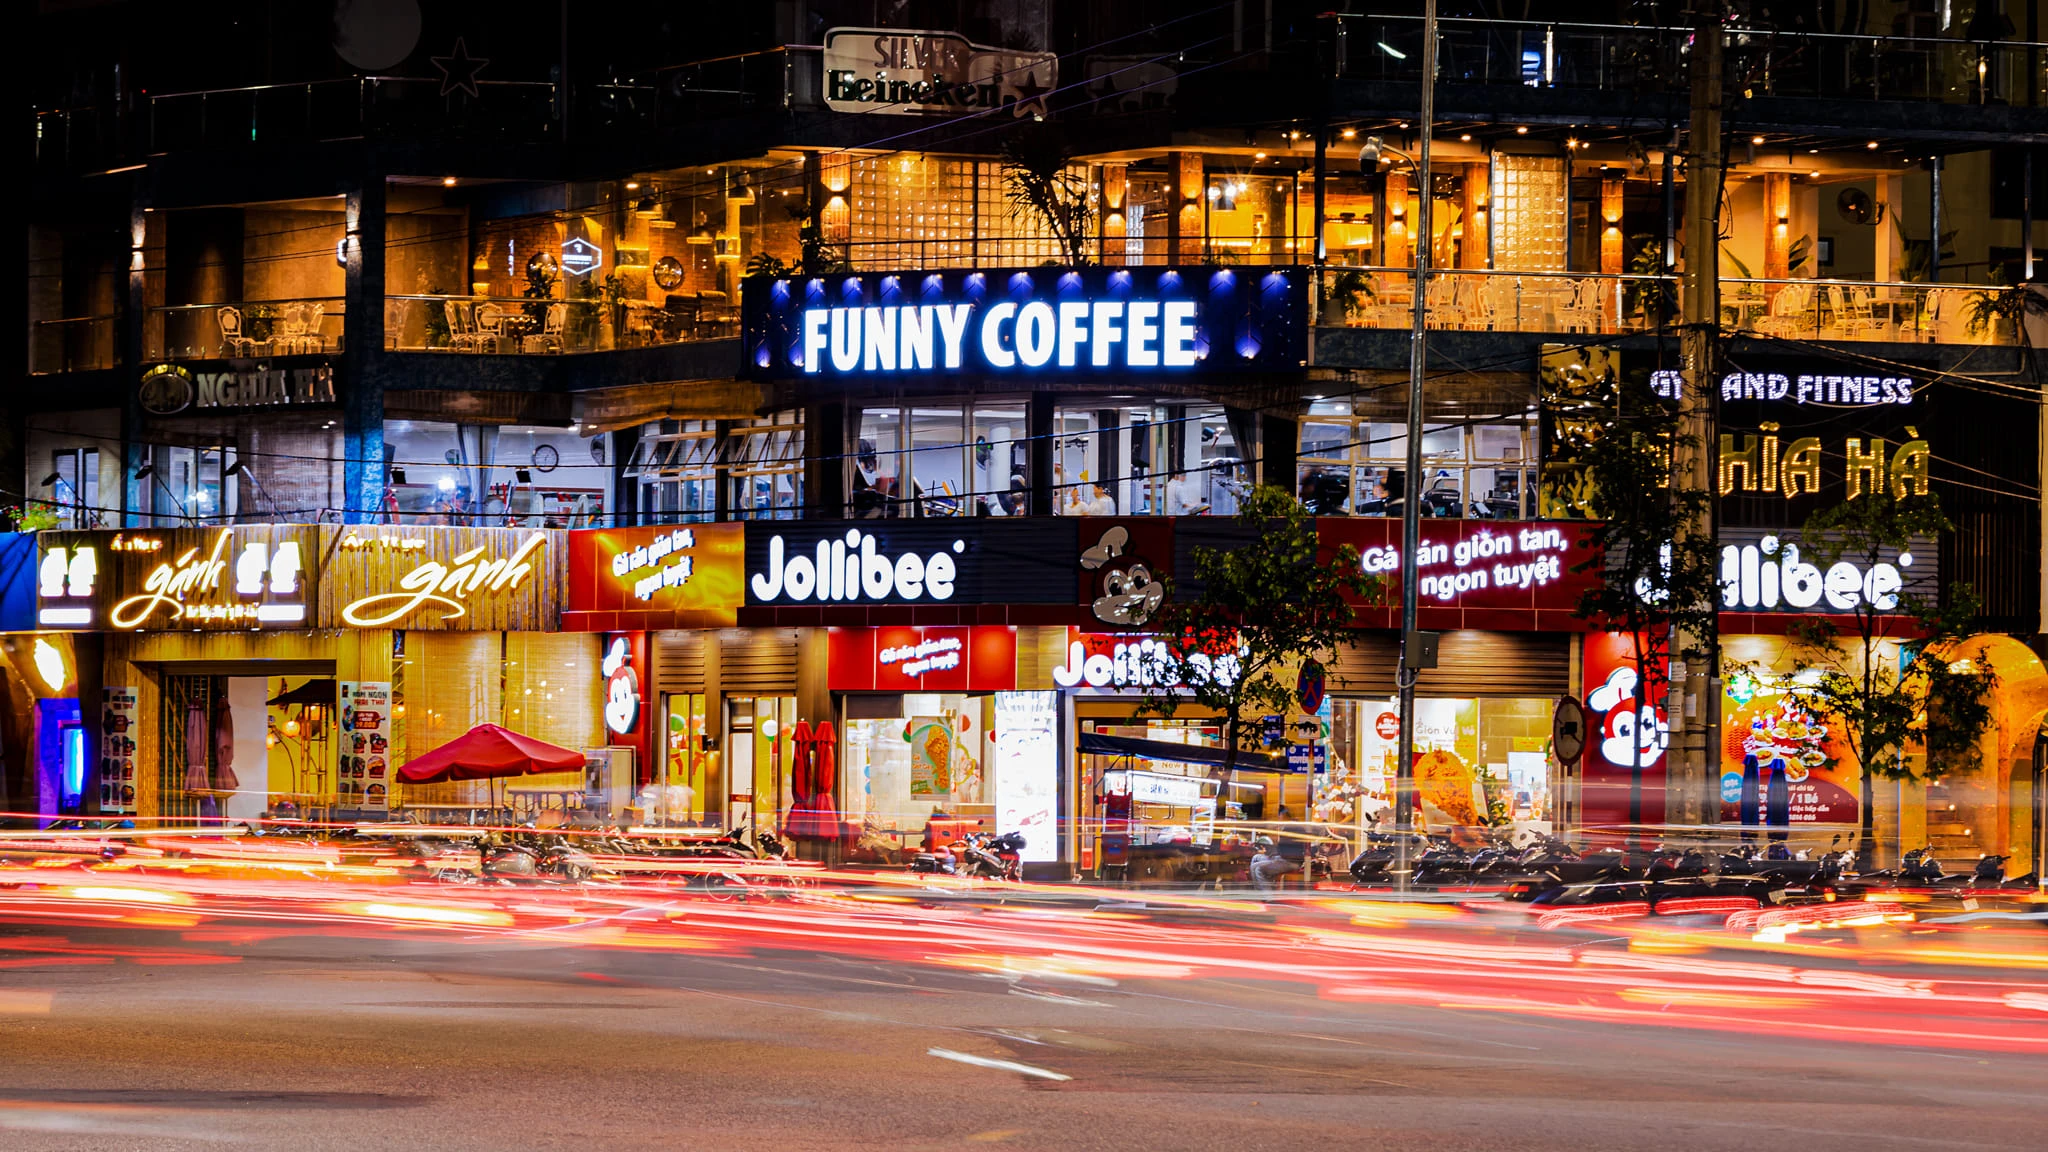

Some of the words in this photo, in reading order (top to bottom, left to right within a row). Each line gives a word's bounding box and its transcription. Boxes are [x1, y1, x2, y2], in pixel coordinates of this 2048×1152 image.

[827, 68, 999, 108] Heineken
[805, 303, 975, 373] FUNNY
[981, 301, 1196, 368] COFFEE
[1721, 372, 1789, 401] AND
[1797, 375, 1913, 404] FITNESS
[1519, 528, 1569, 552] tan,
[751, 528, 957, 602] Jollibee
[1421, 569, 1487, 600] ngon
[1493, 555, 1560, 588] tuyệt
